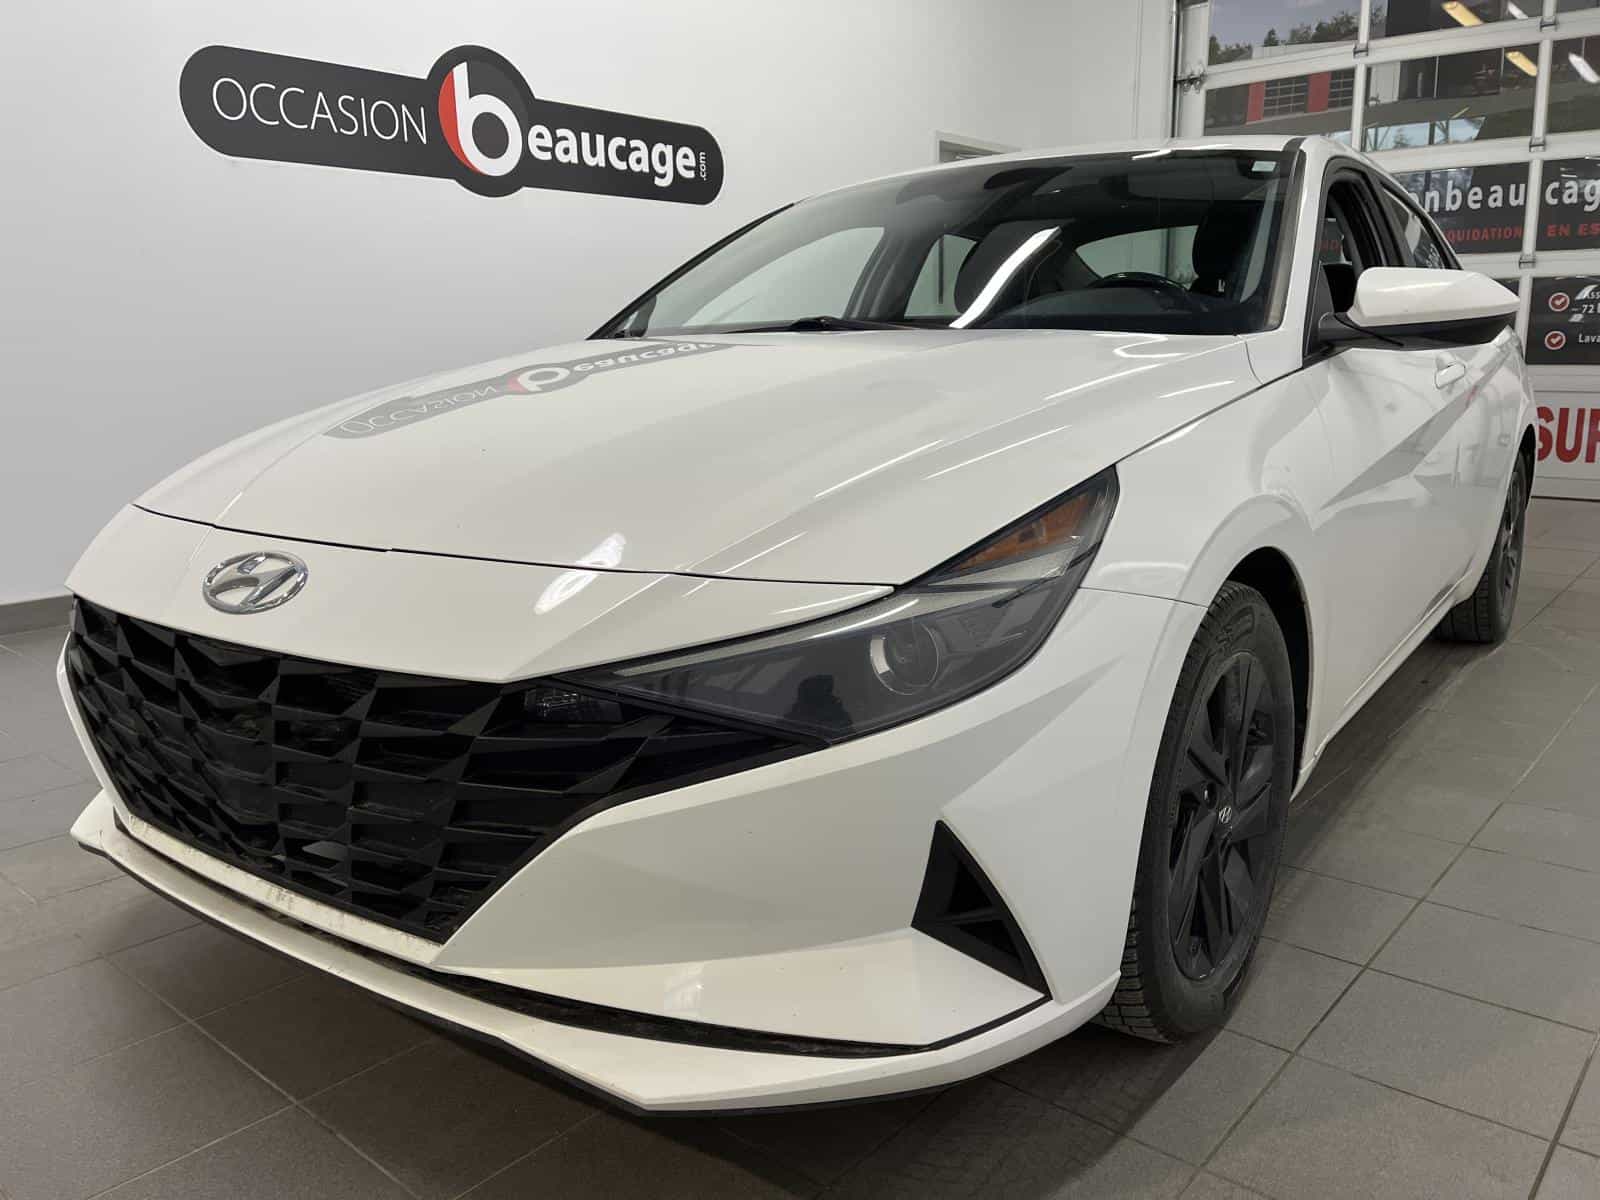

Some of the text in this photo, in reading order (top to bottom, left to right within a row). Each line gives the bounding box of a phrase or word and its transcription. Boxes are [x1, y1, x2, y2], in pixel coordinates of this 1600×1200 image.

[212, 77, 427, 144] OCCASION
[1444, 226, 1523, 243] QUIDATION
[1546, 223, 1571, 237] EN
